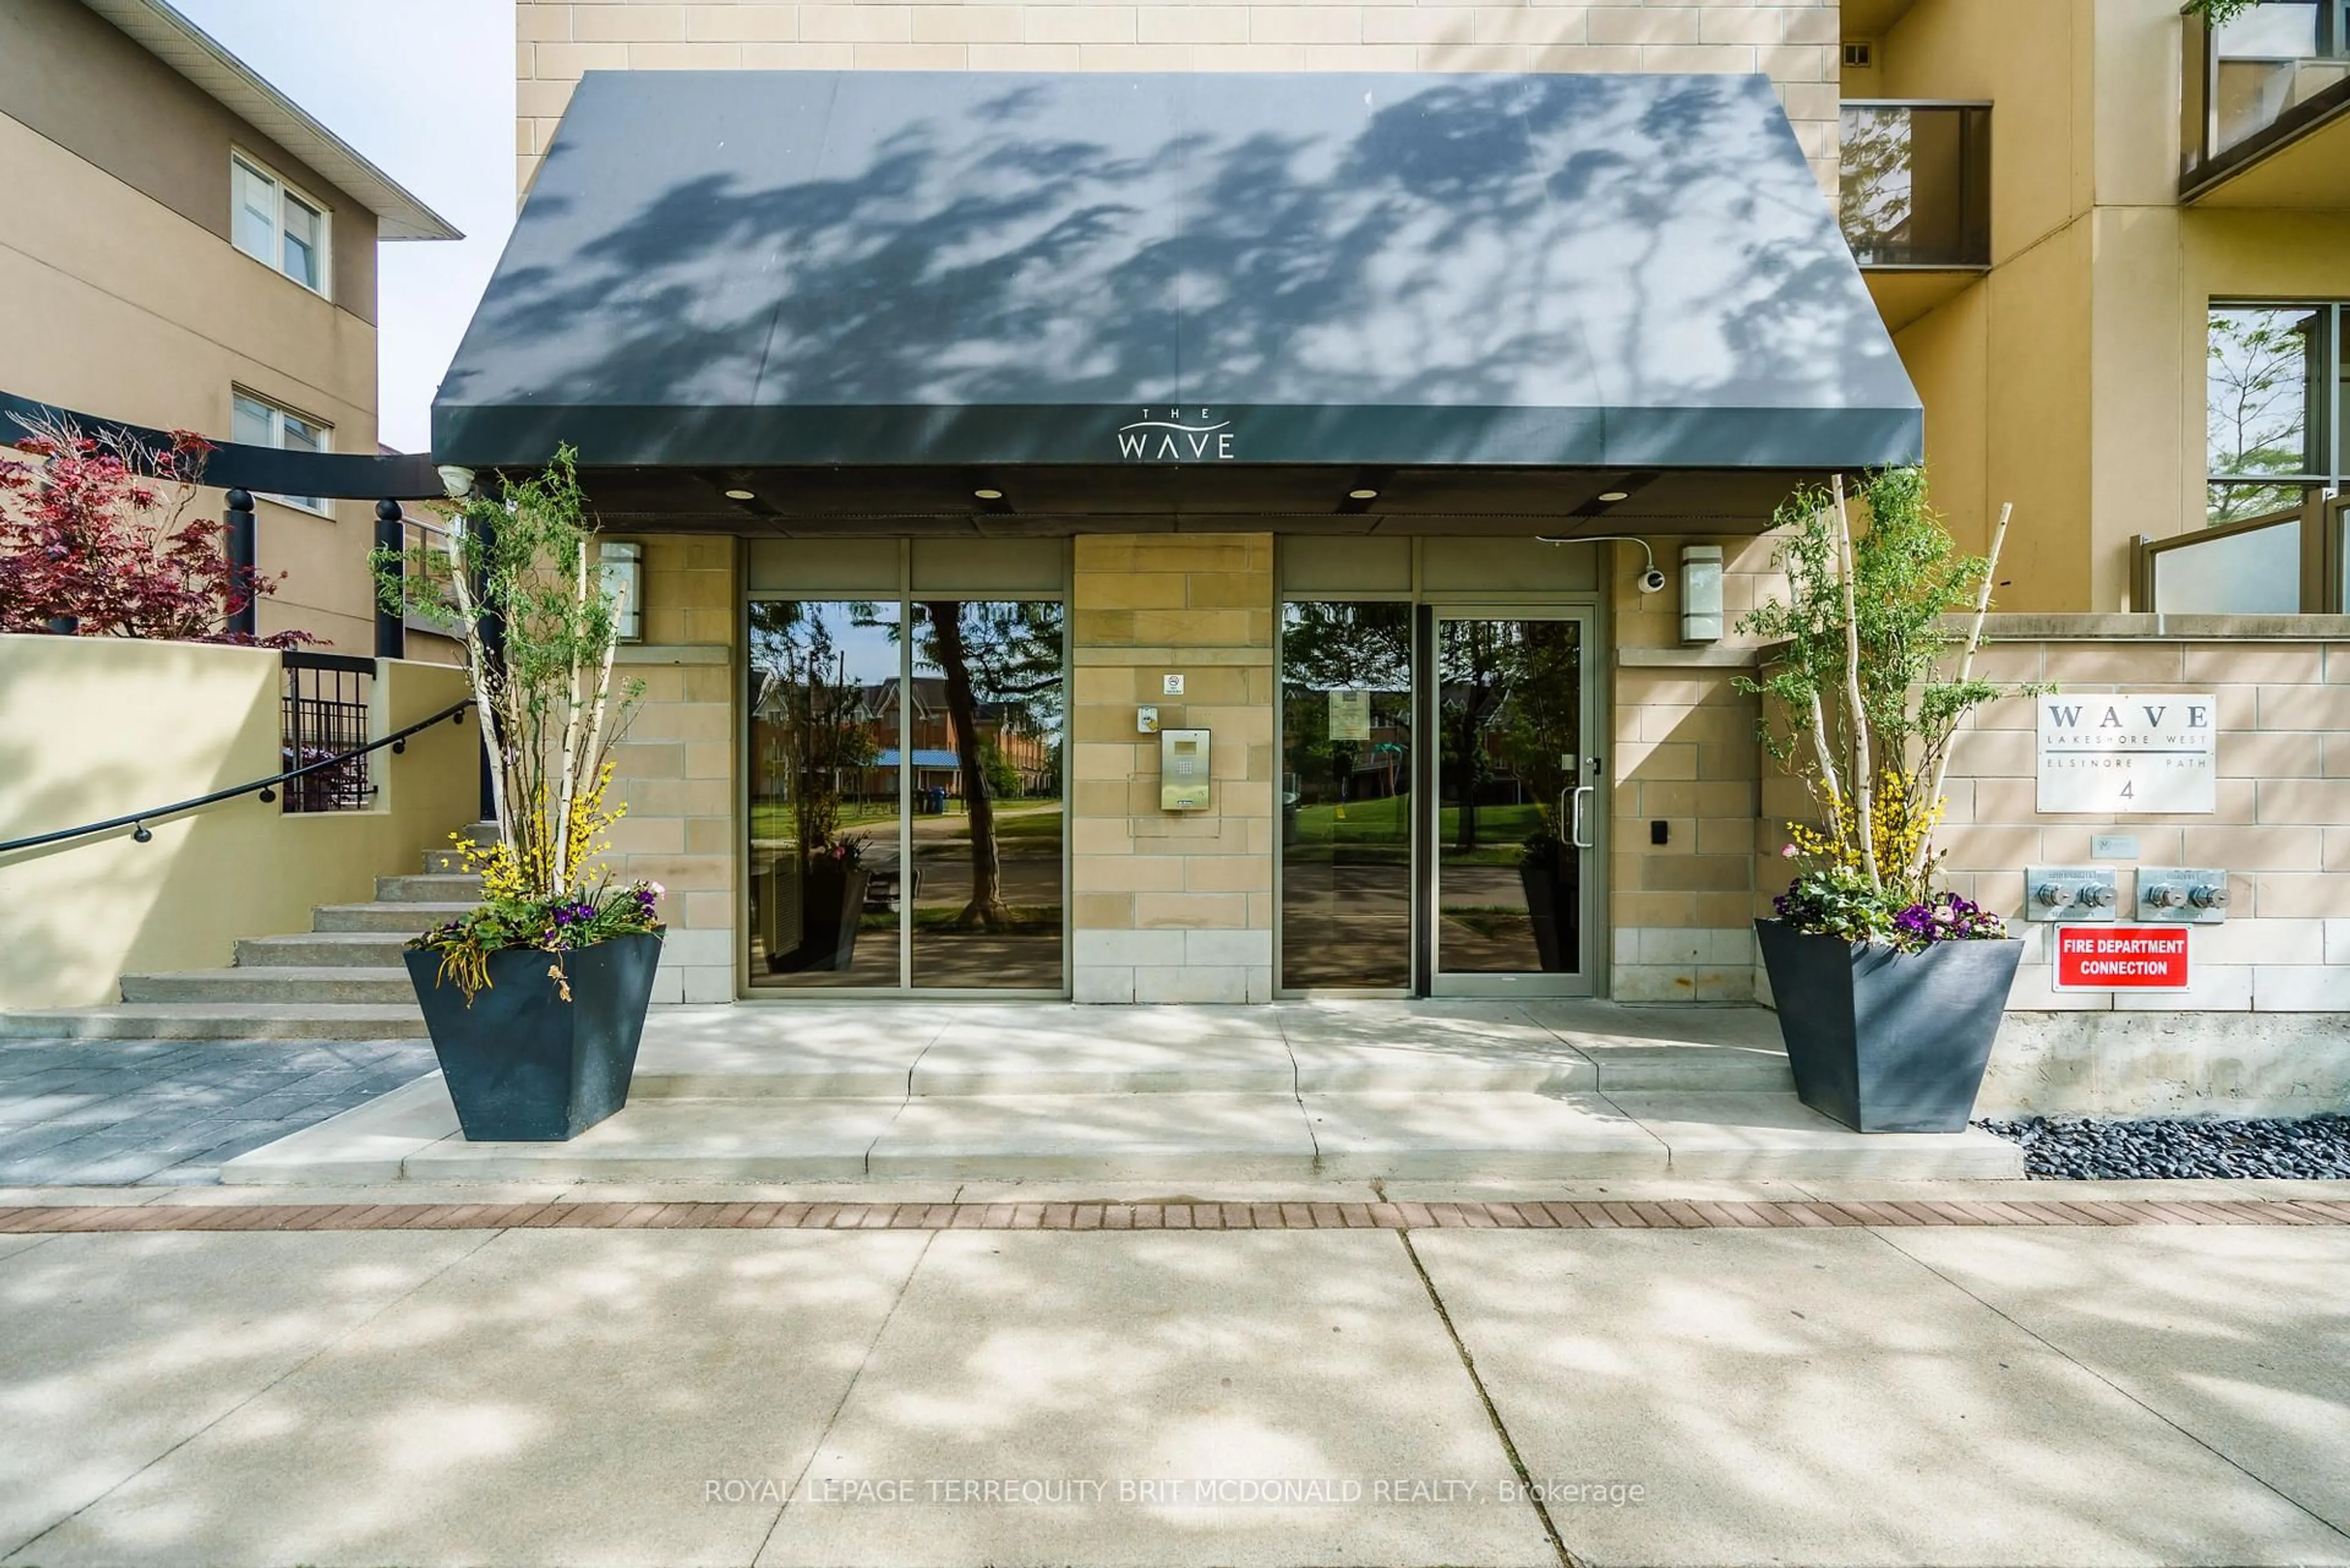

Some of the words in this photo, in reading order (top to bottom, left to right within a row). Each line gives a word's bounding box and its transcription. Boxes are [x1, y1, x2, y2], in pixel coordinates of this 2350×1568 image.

[1142, 408, 1209, 419] THE
[1118, 433, 1234, 459] WAVE
[2048, 706, 2207, 727] WAVE
[2166, 735, 2206, 744] WEST
[2047, 759, 2132, 768] ELSINORE
[2166, 759, 2206, 768] PATH
[2120, 780, 2135, 799] 4
[2064, 940, 2094, 953] FIRE
[2097, 940, 2185, 954] DEPARTMENT
[2081, 961, 2168, 975] CONNECTION
